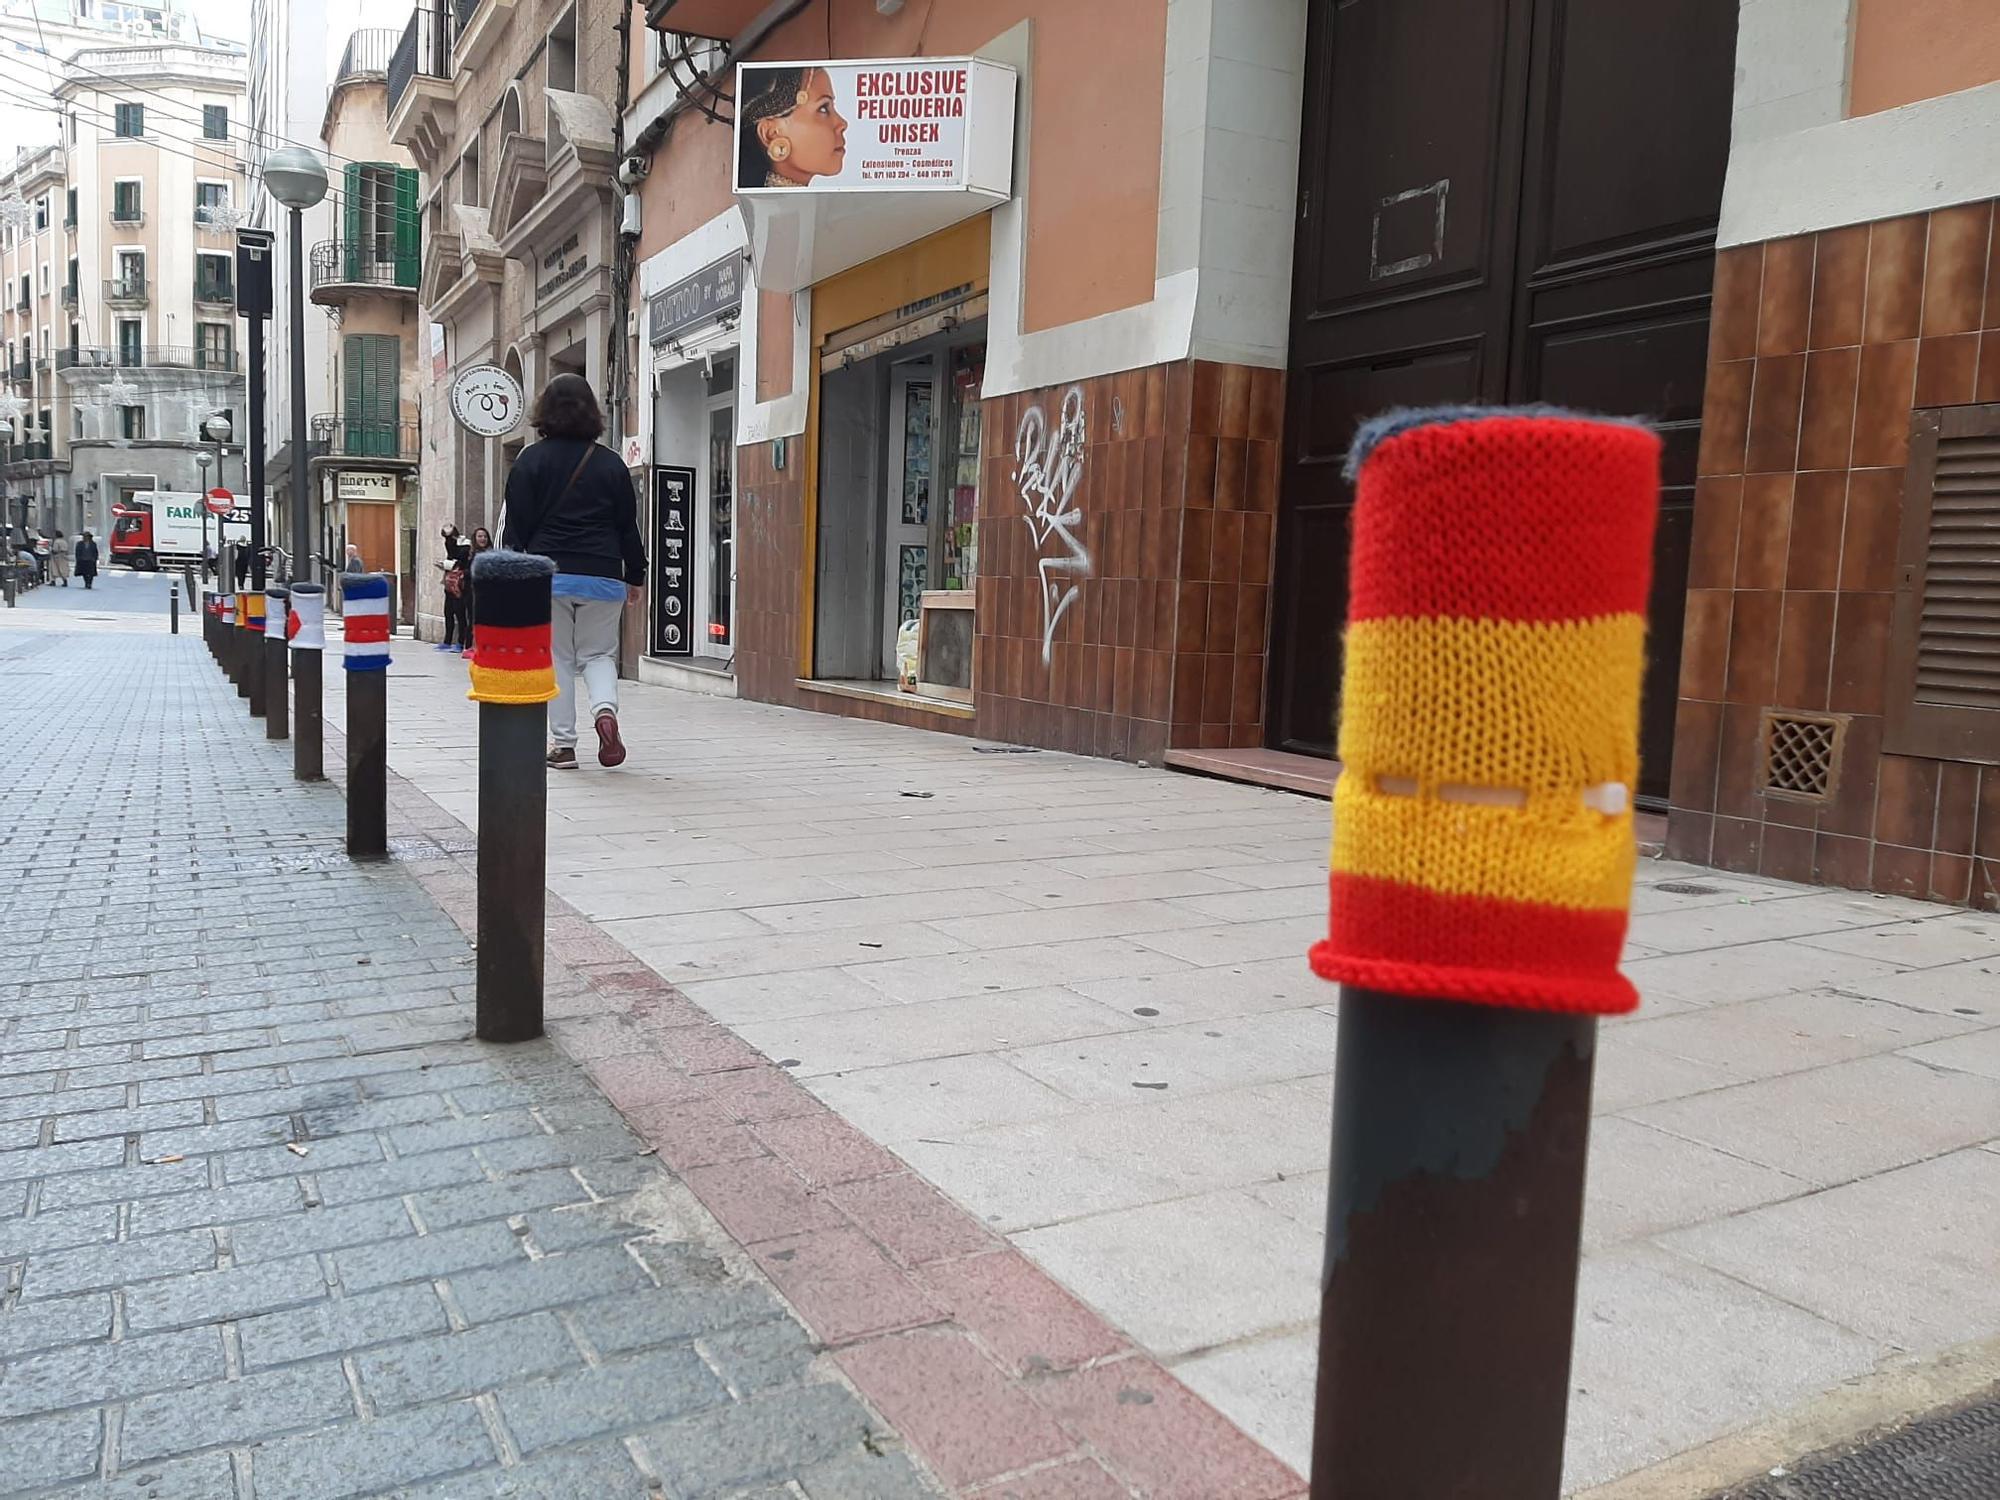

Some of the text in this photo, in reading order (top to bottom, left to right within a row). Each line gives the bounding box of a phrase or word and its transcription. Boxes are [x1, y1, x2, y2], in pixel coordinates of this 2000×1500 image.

[856, 70, 966, 97] EXCLUSIVE
[857, 96, 963, 119] PELUQUERIA
[879, 122, 939, 143] UNISEX
[894, 147, 921, 156] Trenzas
[862, 159, 904, 169] Extensiones
[655, 282, 700, 331] TATTOO
[340, 472, 392, 488] minerva
[663, 479, 686, 645] TATTOO
